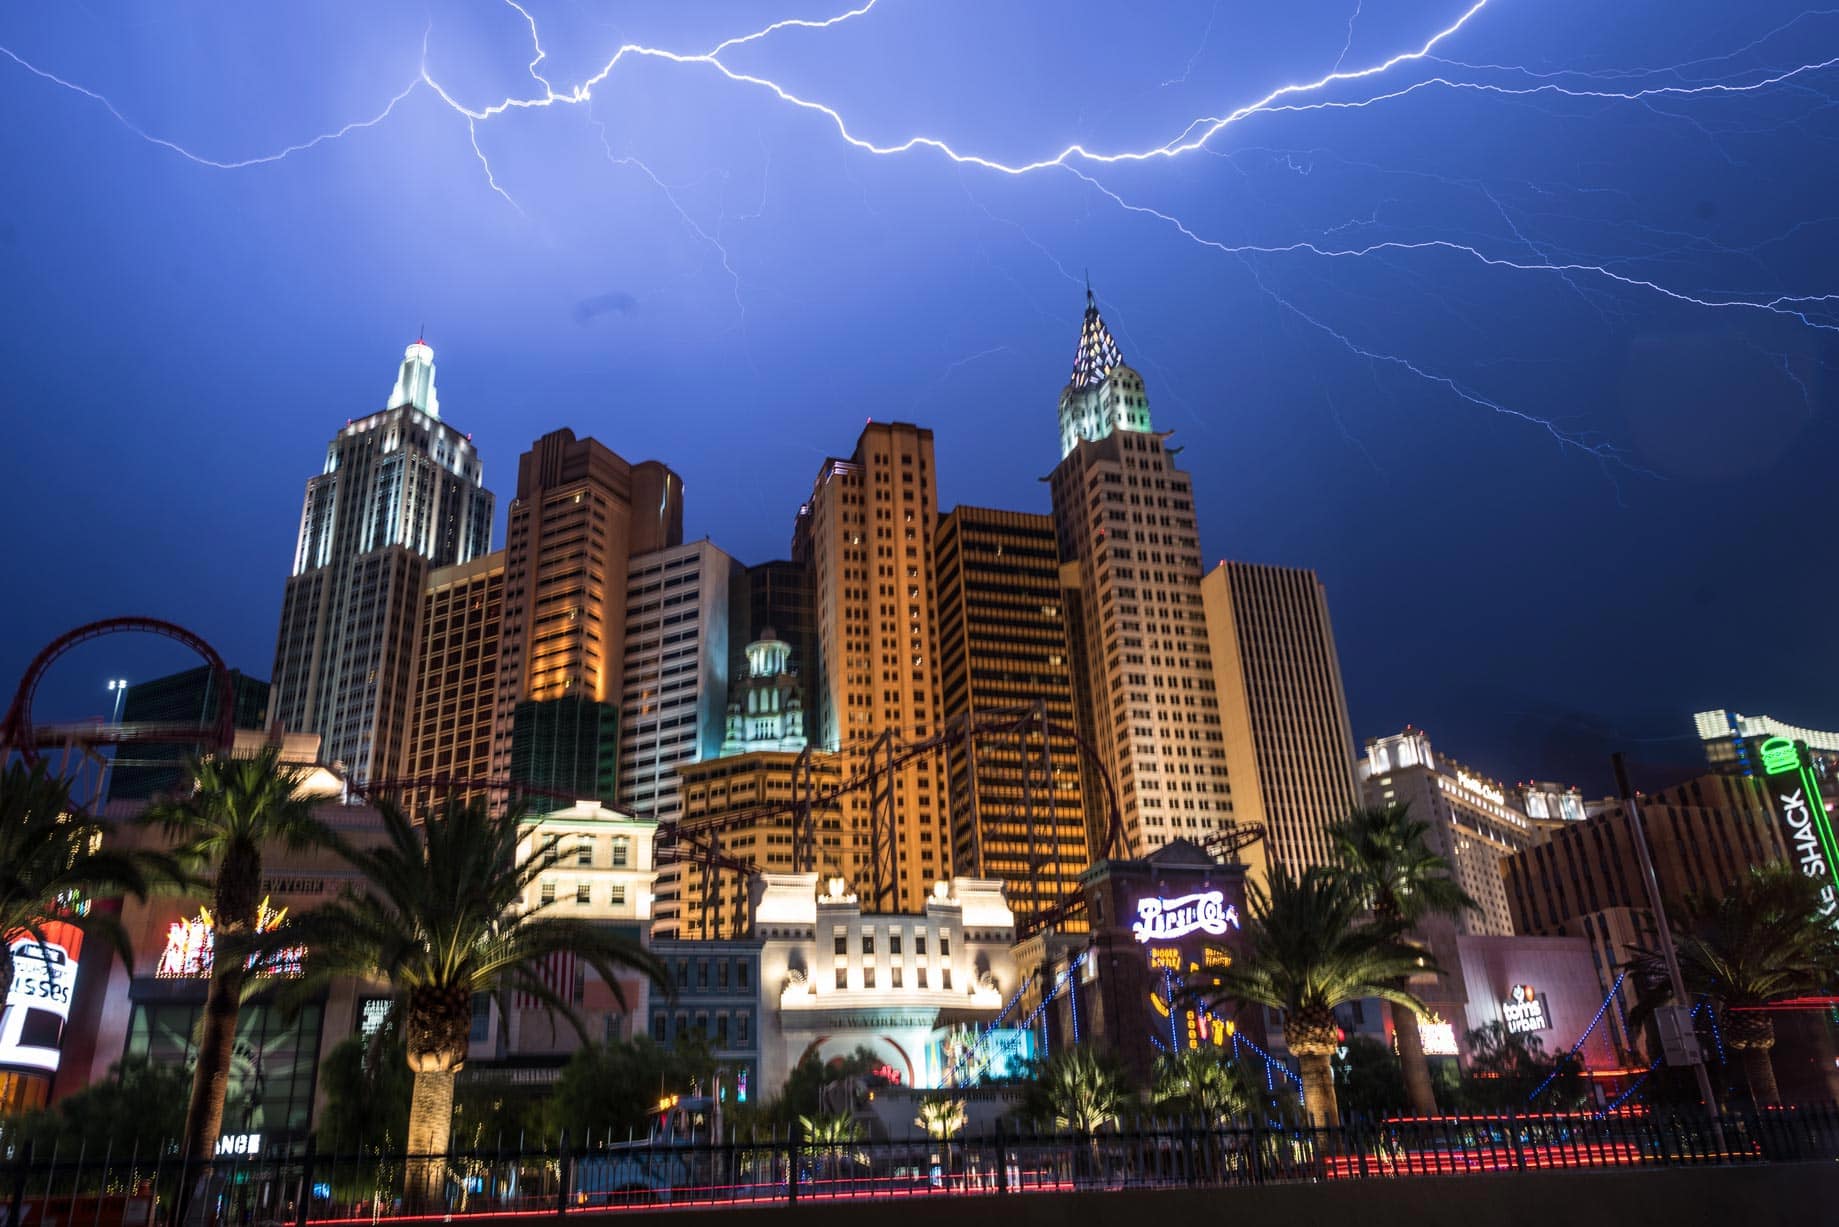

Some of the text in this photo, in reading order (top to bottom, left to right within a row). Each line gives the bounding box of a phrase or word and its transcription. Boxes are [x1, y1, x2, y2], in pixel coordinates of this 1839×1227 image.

[1780, 788, 1826, 878] SHACK
[1503, 999, 1542, 1021] toms
[1508, 1015, 1546, 1034] urban
